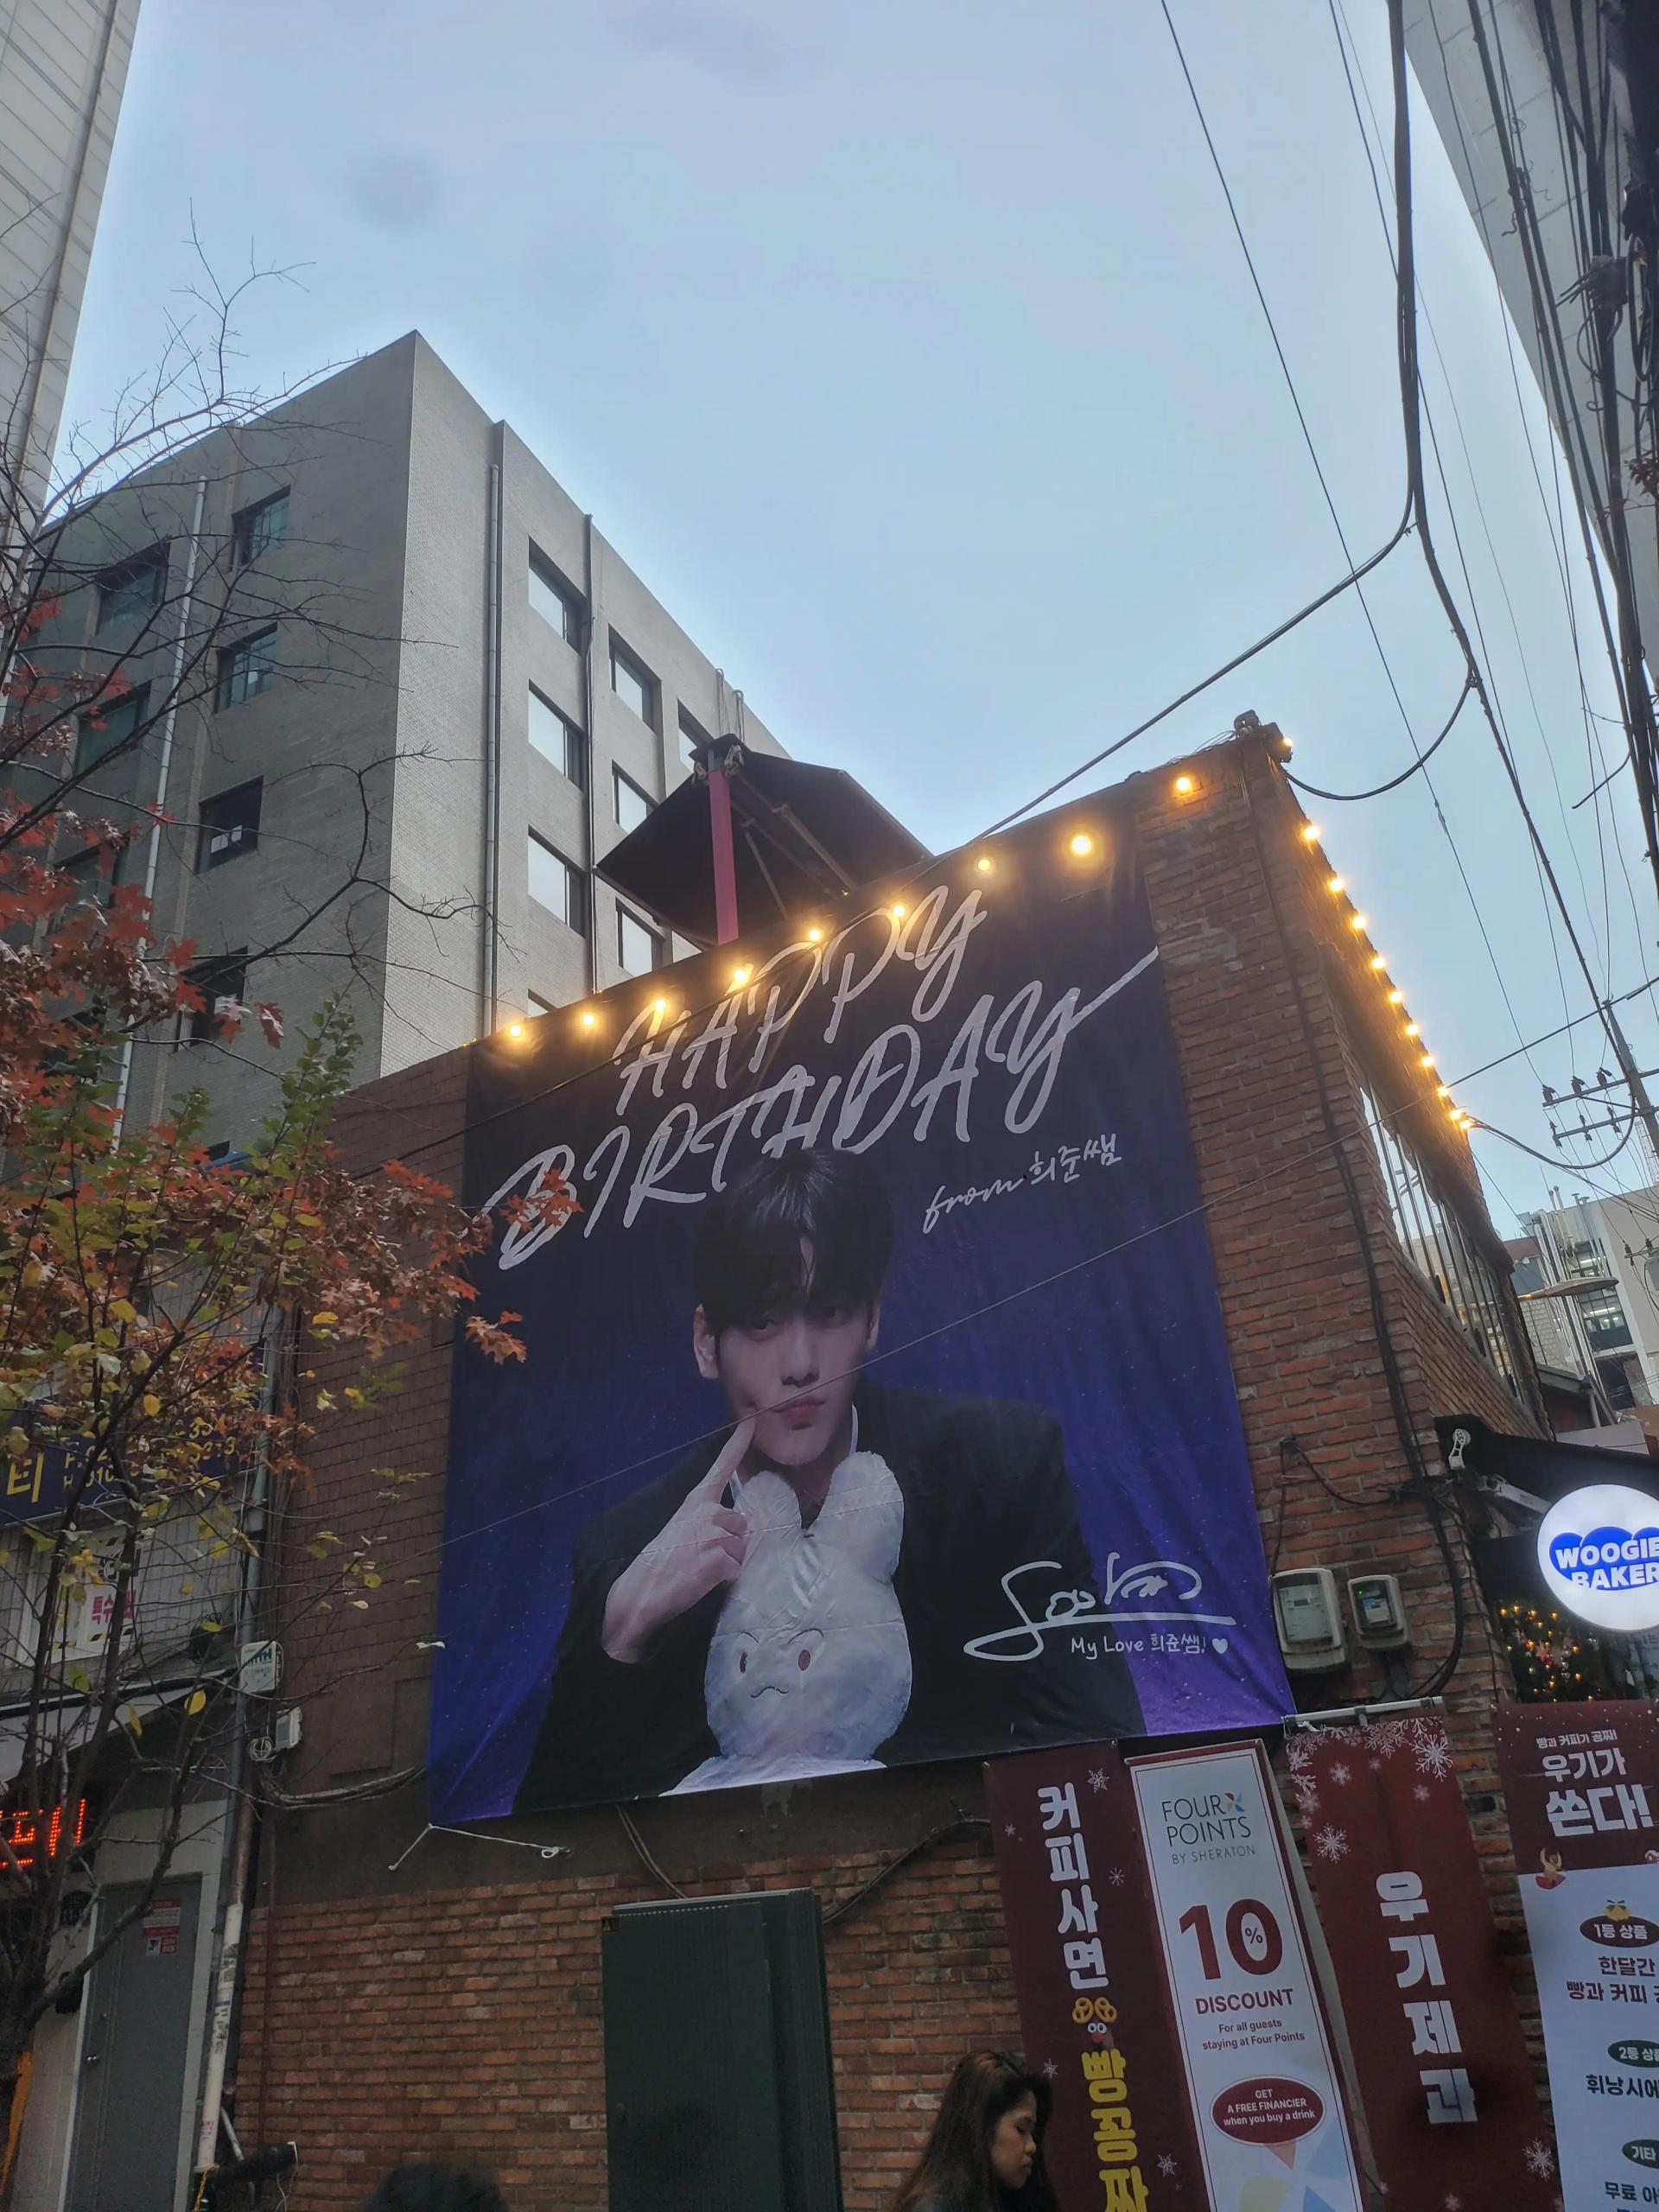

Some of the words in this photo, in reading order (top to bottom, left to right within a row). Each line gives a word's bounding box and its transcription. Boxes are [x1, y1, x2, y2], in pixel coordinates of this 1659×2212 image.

[613, 885, 988, 1116] HAPPY
[478, 946, 1159, 1270] BIRTHDAY
[923, 1177, 1024, 1234] from
[1029, 1133, 1122, 1184] 희준쌤
[1555, 1536, 1659, 1569] WOOGIE
[1071, 1637, 1098, 1659] My
[1103, 1635, 1144, 1654] Love
[1535, 1737, 1557, 1749] 빵과
[1542, 1747, 1626, 1782] 우기가
[1161, 1795, 1226, 1821] FOUR
[1546, 1783, 1654, 1837] 쏜다!
[1166, 1816, 1251, 1847] POINTS
[1172, 1853, 1185, 1865] BY
[1191, 1845, 1255, 1862] SHERATON
[1037, 1782, 1109, 1989] 커피사면
[1179, 1898, 1283, 1980] 10%
[1594, 1923, 1616, 1938] 1등
[1619, 1923, 1648, 1940] 상품
[1599, 1956, 1656, 1977] 한달간
[1196, 1988, 1294, 2014] DISCOUNT
[1376, 1870, 1478, 2124] 우기제과
[1567, 1980, 1605, 2002] 빵과
[1610, 1983, 1648, 2004] 커피
[1218, 2023, 1234, 2033] For
[1236, 2021, 1248, 2031] all
[1249, 2018, 1282, 2032] guests
[1202, 2037, 1238, 2050] staying
[1239, 2037, 1249, 2046] at
[1251, 2035, 1272, 2045] Four
[1274, 2031, 1306, 2043] Points
[1618, 2046, 1639, 2060] 2등
[1227, 2104, 1234, 2113] A
[1236, 2102, 1257, 2113] FREE
[1259, 2098, 1307, 2110] FINANCIER
[1255, 2088, 1273, 2099] GET
[1224, 2116, 1248, 2126] when
[1249, 2115, 1265, 2126] you
[1267, 2113, 1283, 2123] buy
[1293, 2109, 1316, 2120] drink
[1630, 2145, 1657, 2162] 기타
[1605, 2181, 1637, 2201] 무료
